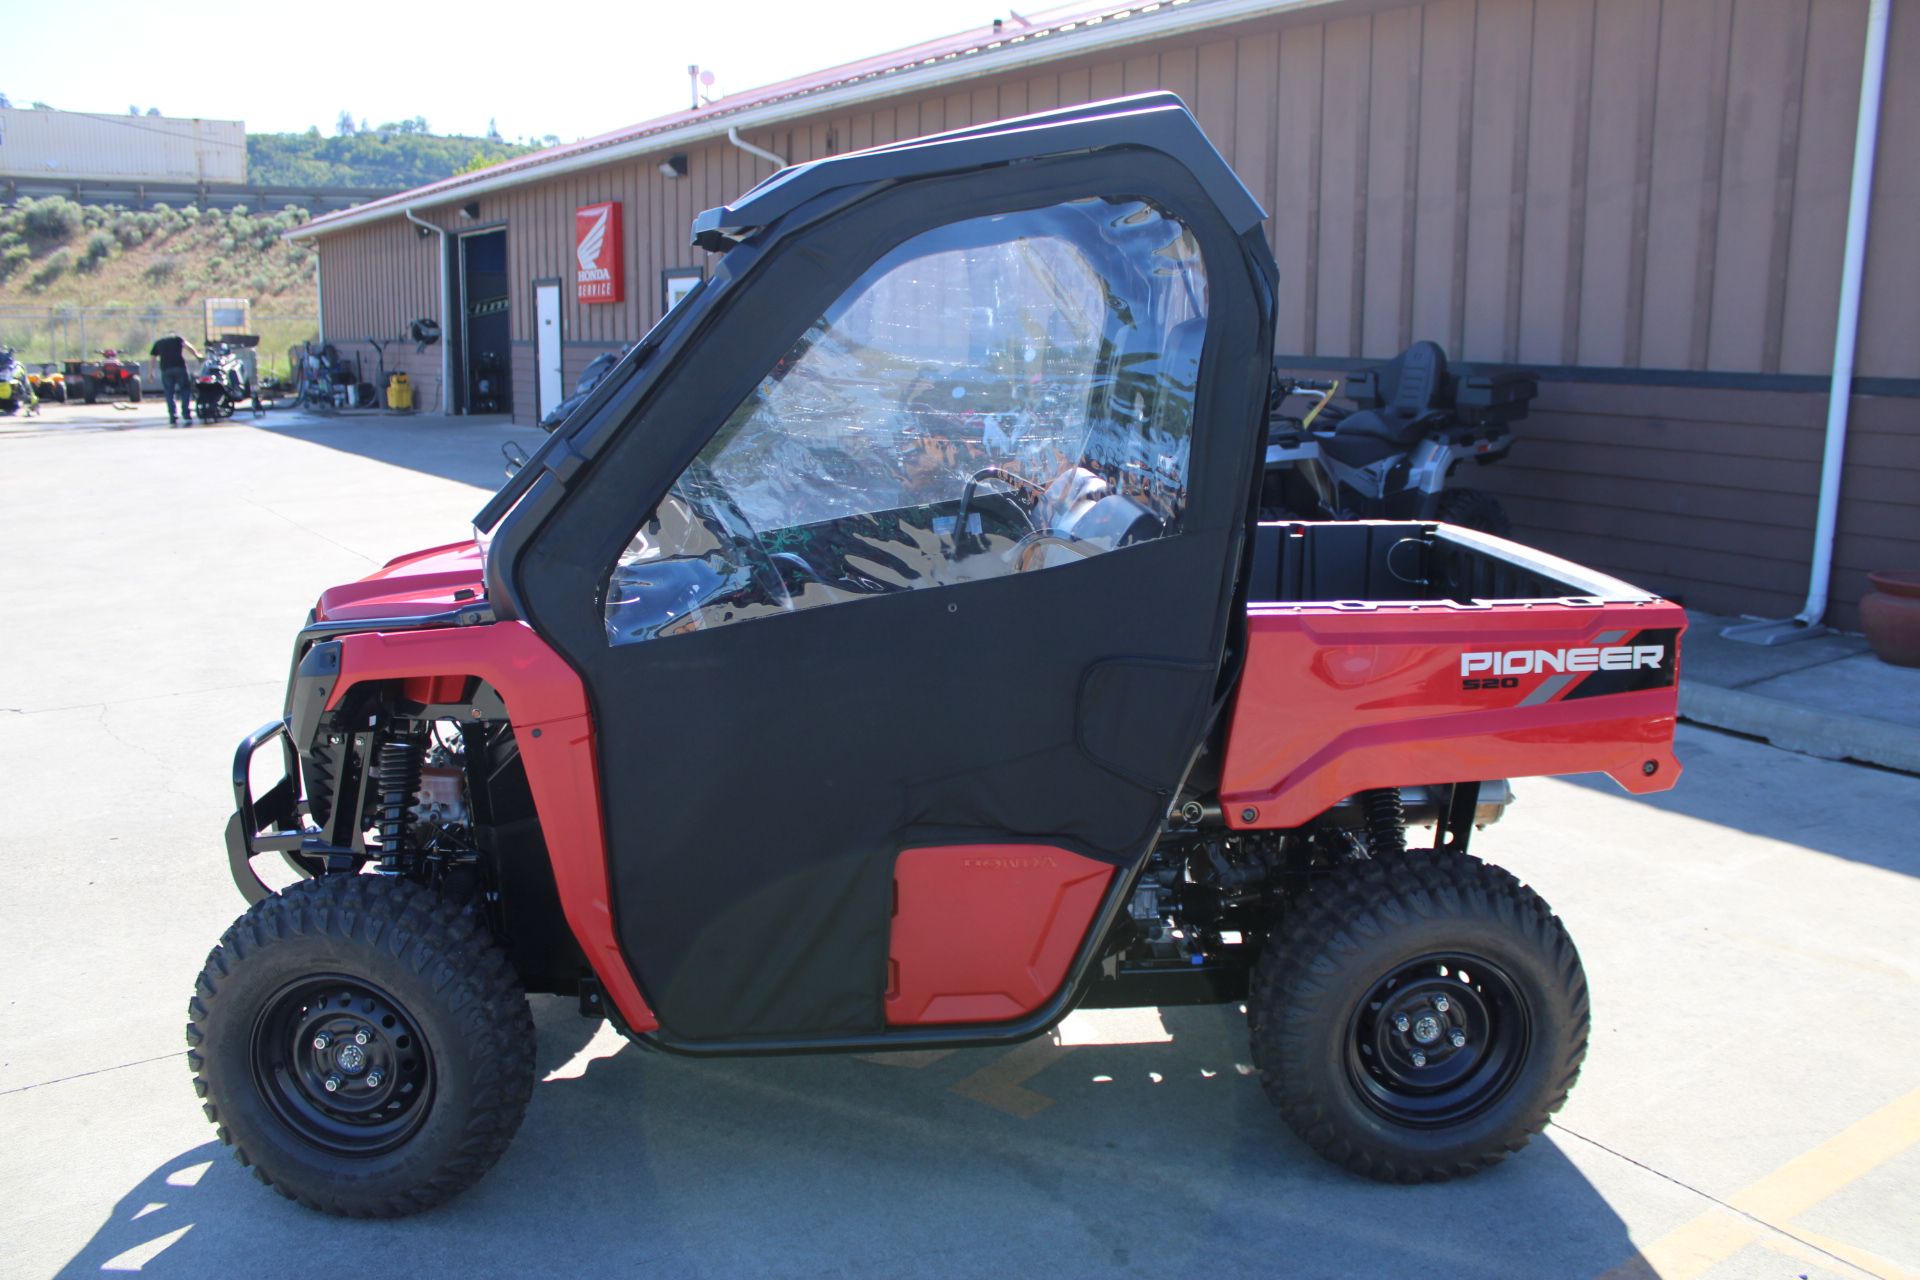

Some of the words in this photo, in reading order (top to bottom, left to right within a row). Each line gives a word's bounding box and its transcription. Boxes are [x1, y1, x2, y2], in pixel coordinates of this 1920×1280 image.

[578, 268, 611, 282] HONDA
[578, 283, 612, 297] SERVICE
[1461, 645, 1665, 677] PIONEER
[1462, 677, 1519, 691] 520
[962, 856, 1058, 869] HONDA
